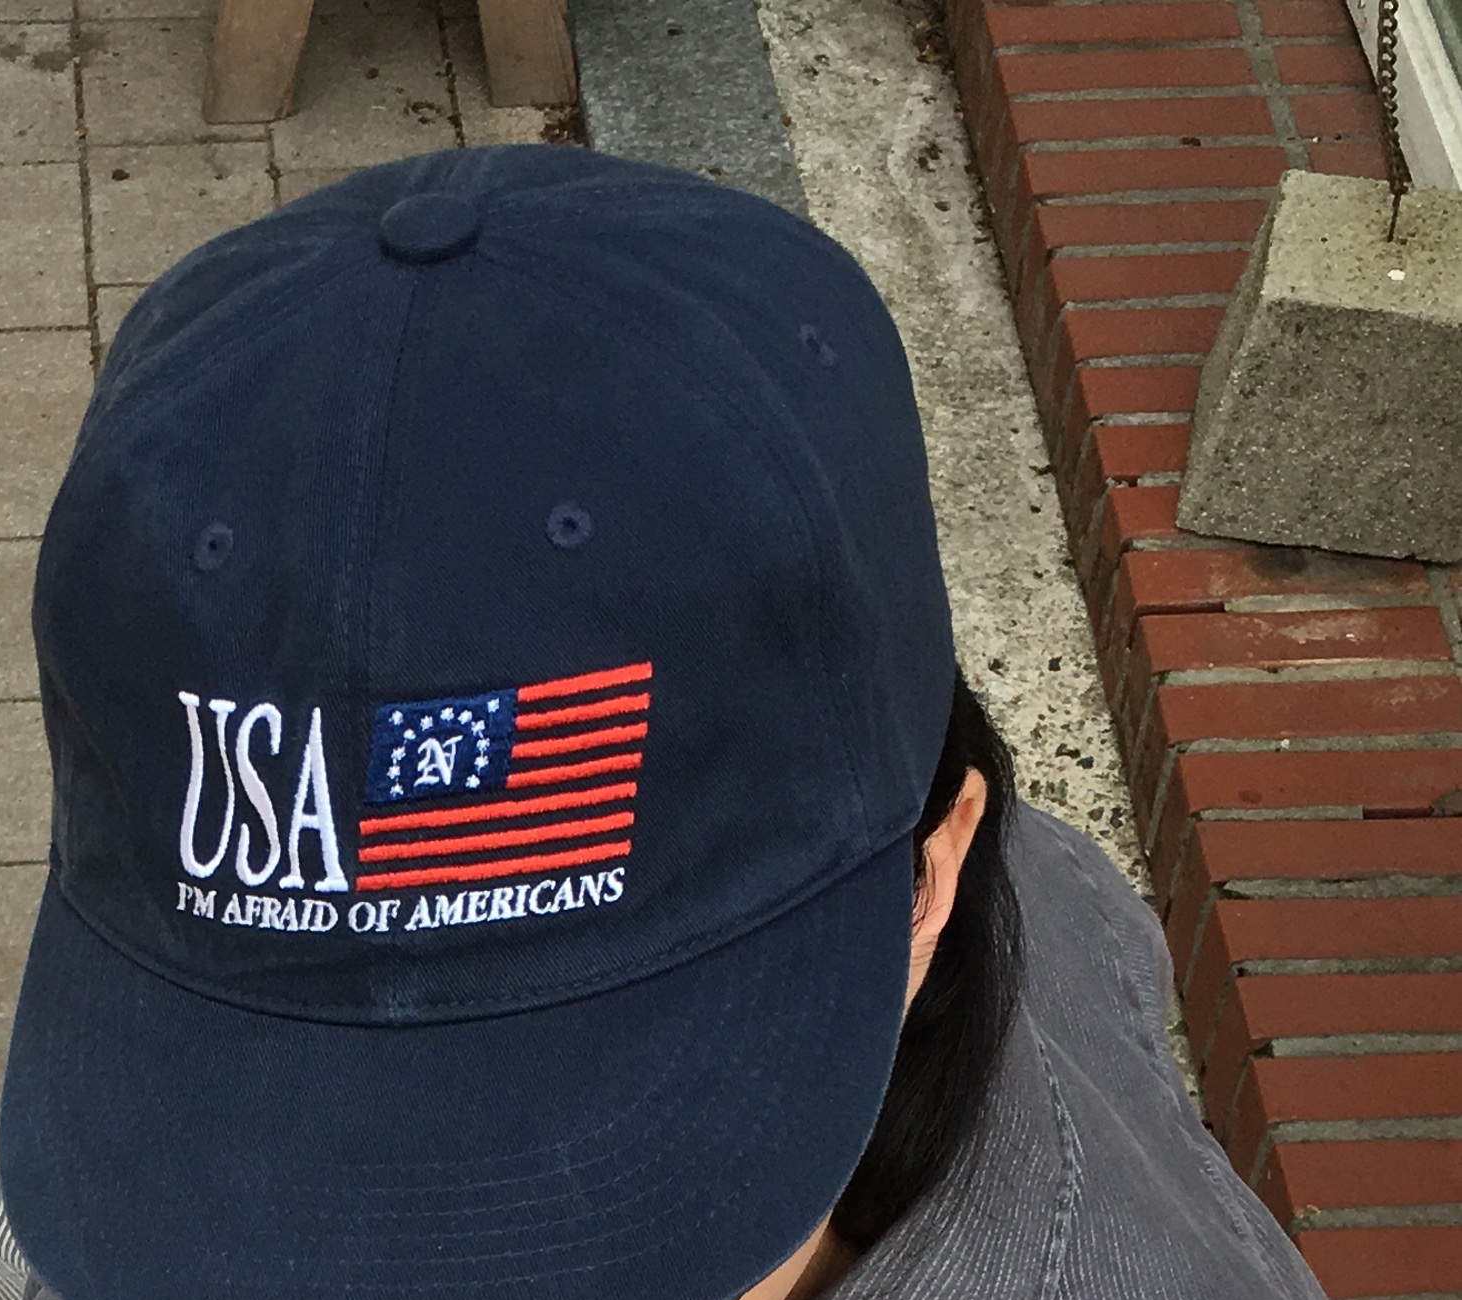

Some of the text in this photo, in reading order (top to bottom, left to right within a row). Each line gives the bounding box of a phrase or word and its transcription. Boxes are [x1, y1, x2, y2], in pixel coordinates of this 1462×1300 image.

[178, 691, 349, 892] USA
[176, 867, 625, 933] I'M AFRAID OF AMERICANS
